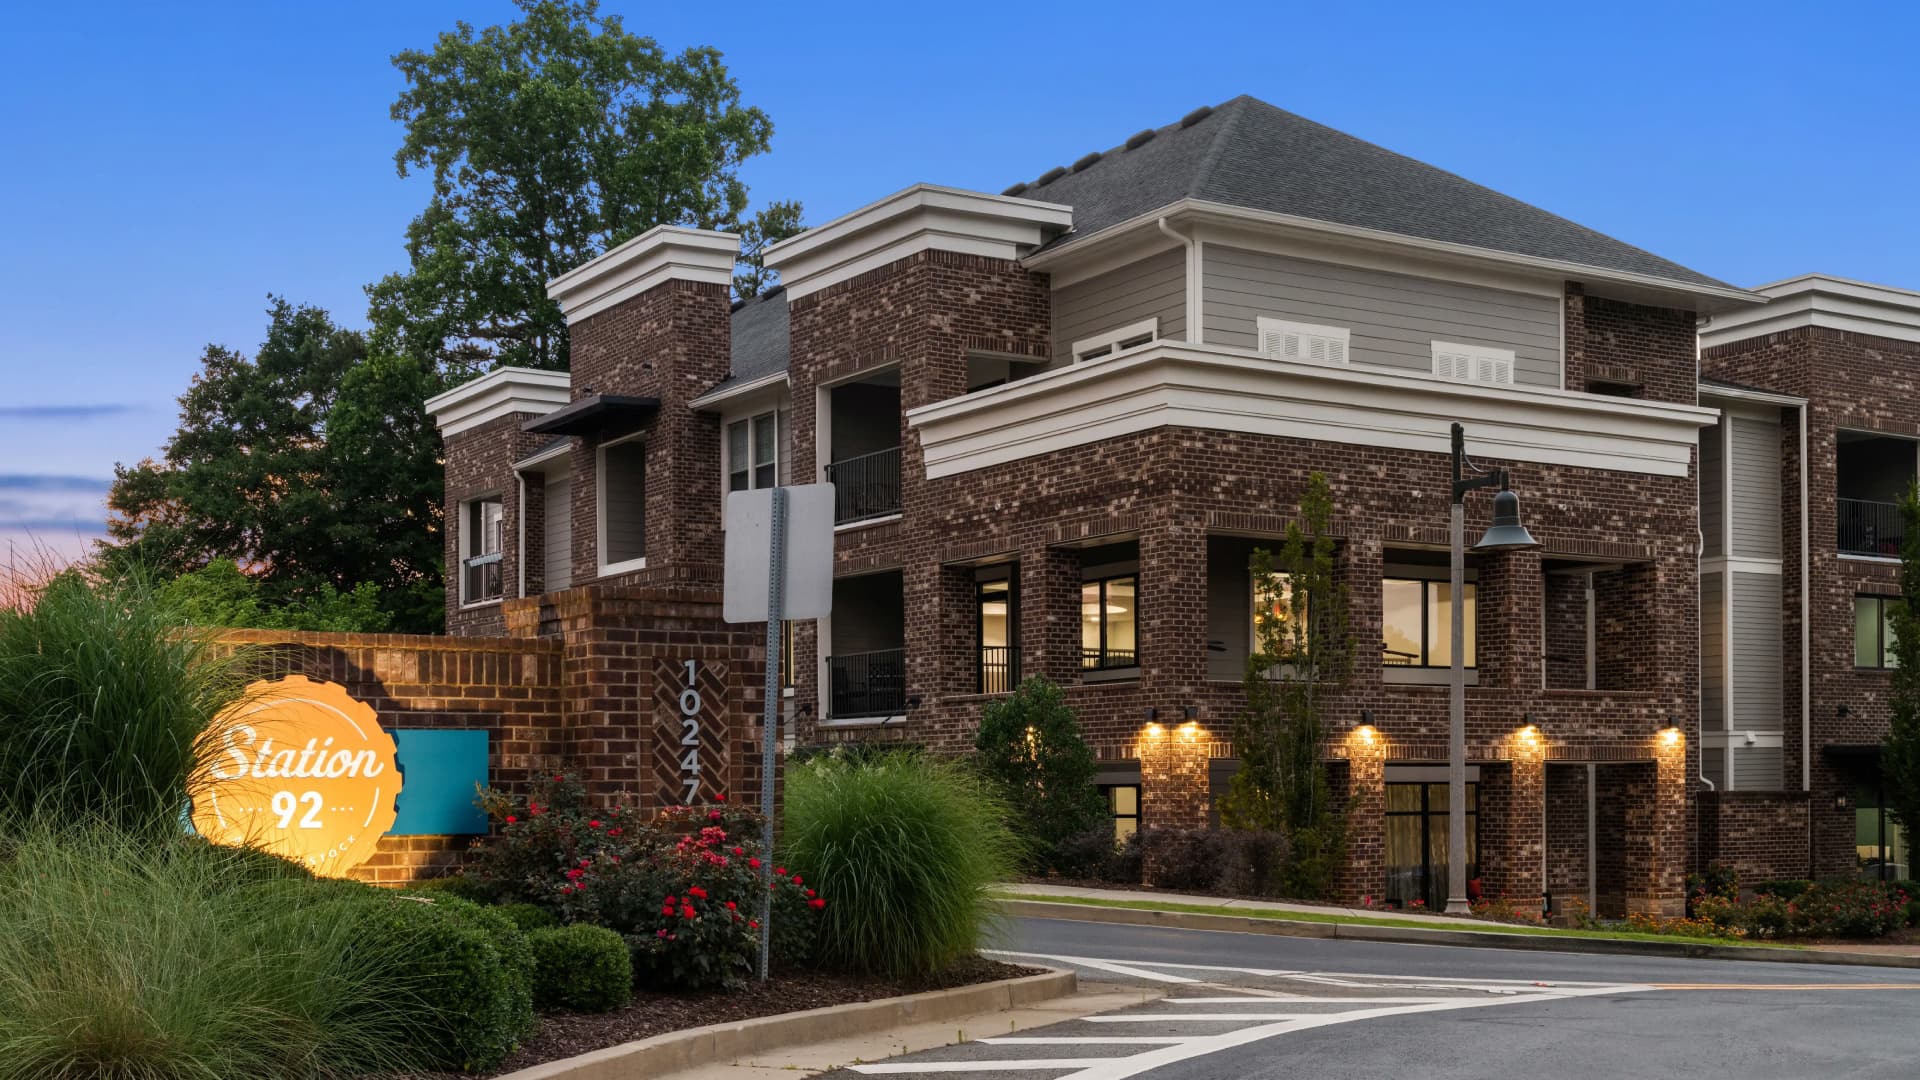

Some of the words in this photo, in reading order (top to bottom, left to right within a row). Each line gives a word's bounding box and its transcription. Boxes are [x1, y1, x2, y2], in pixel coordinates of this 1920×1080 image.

[210, 725, 384, 778] Station
[679, 659, 701, 804] 10247
[271, 791, 322, 828] 92
